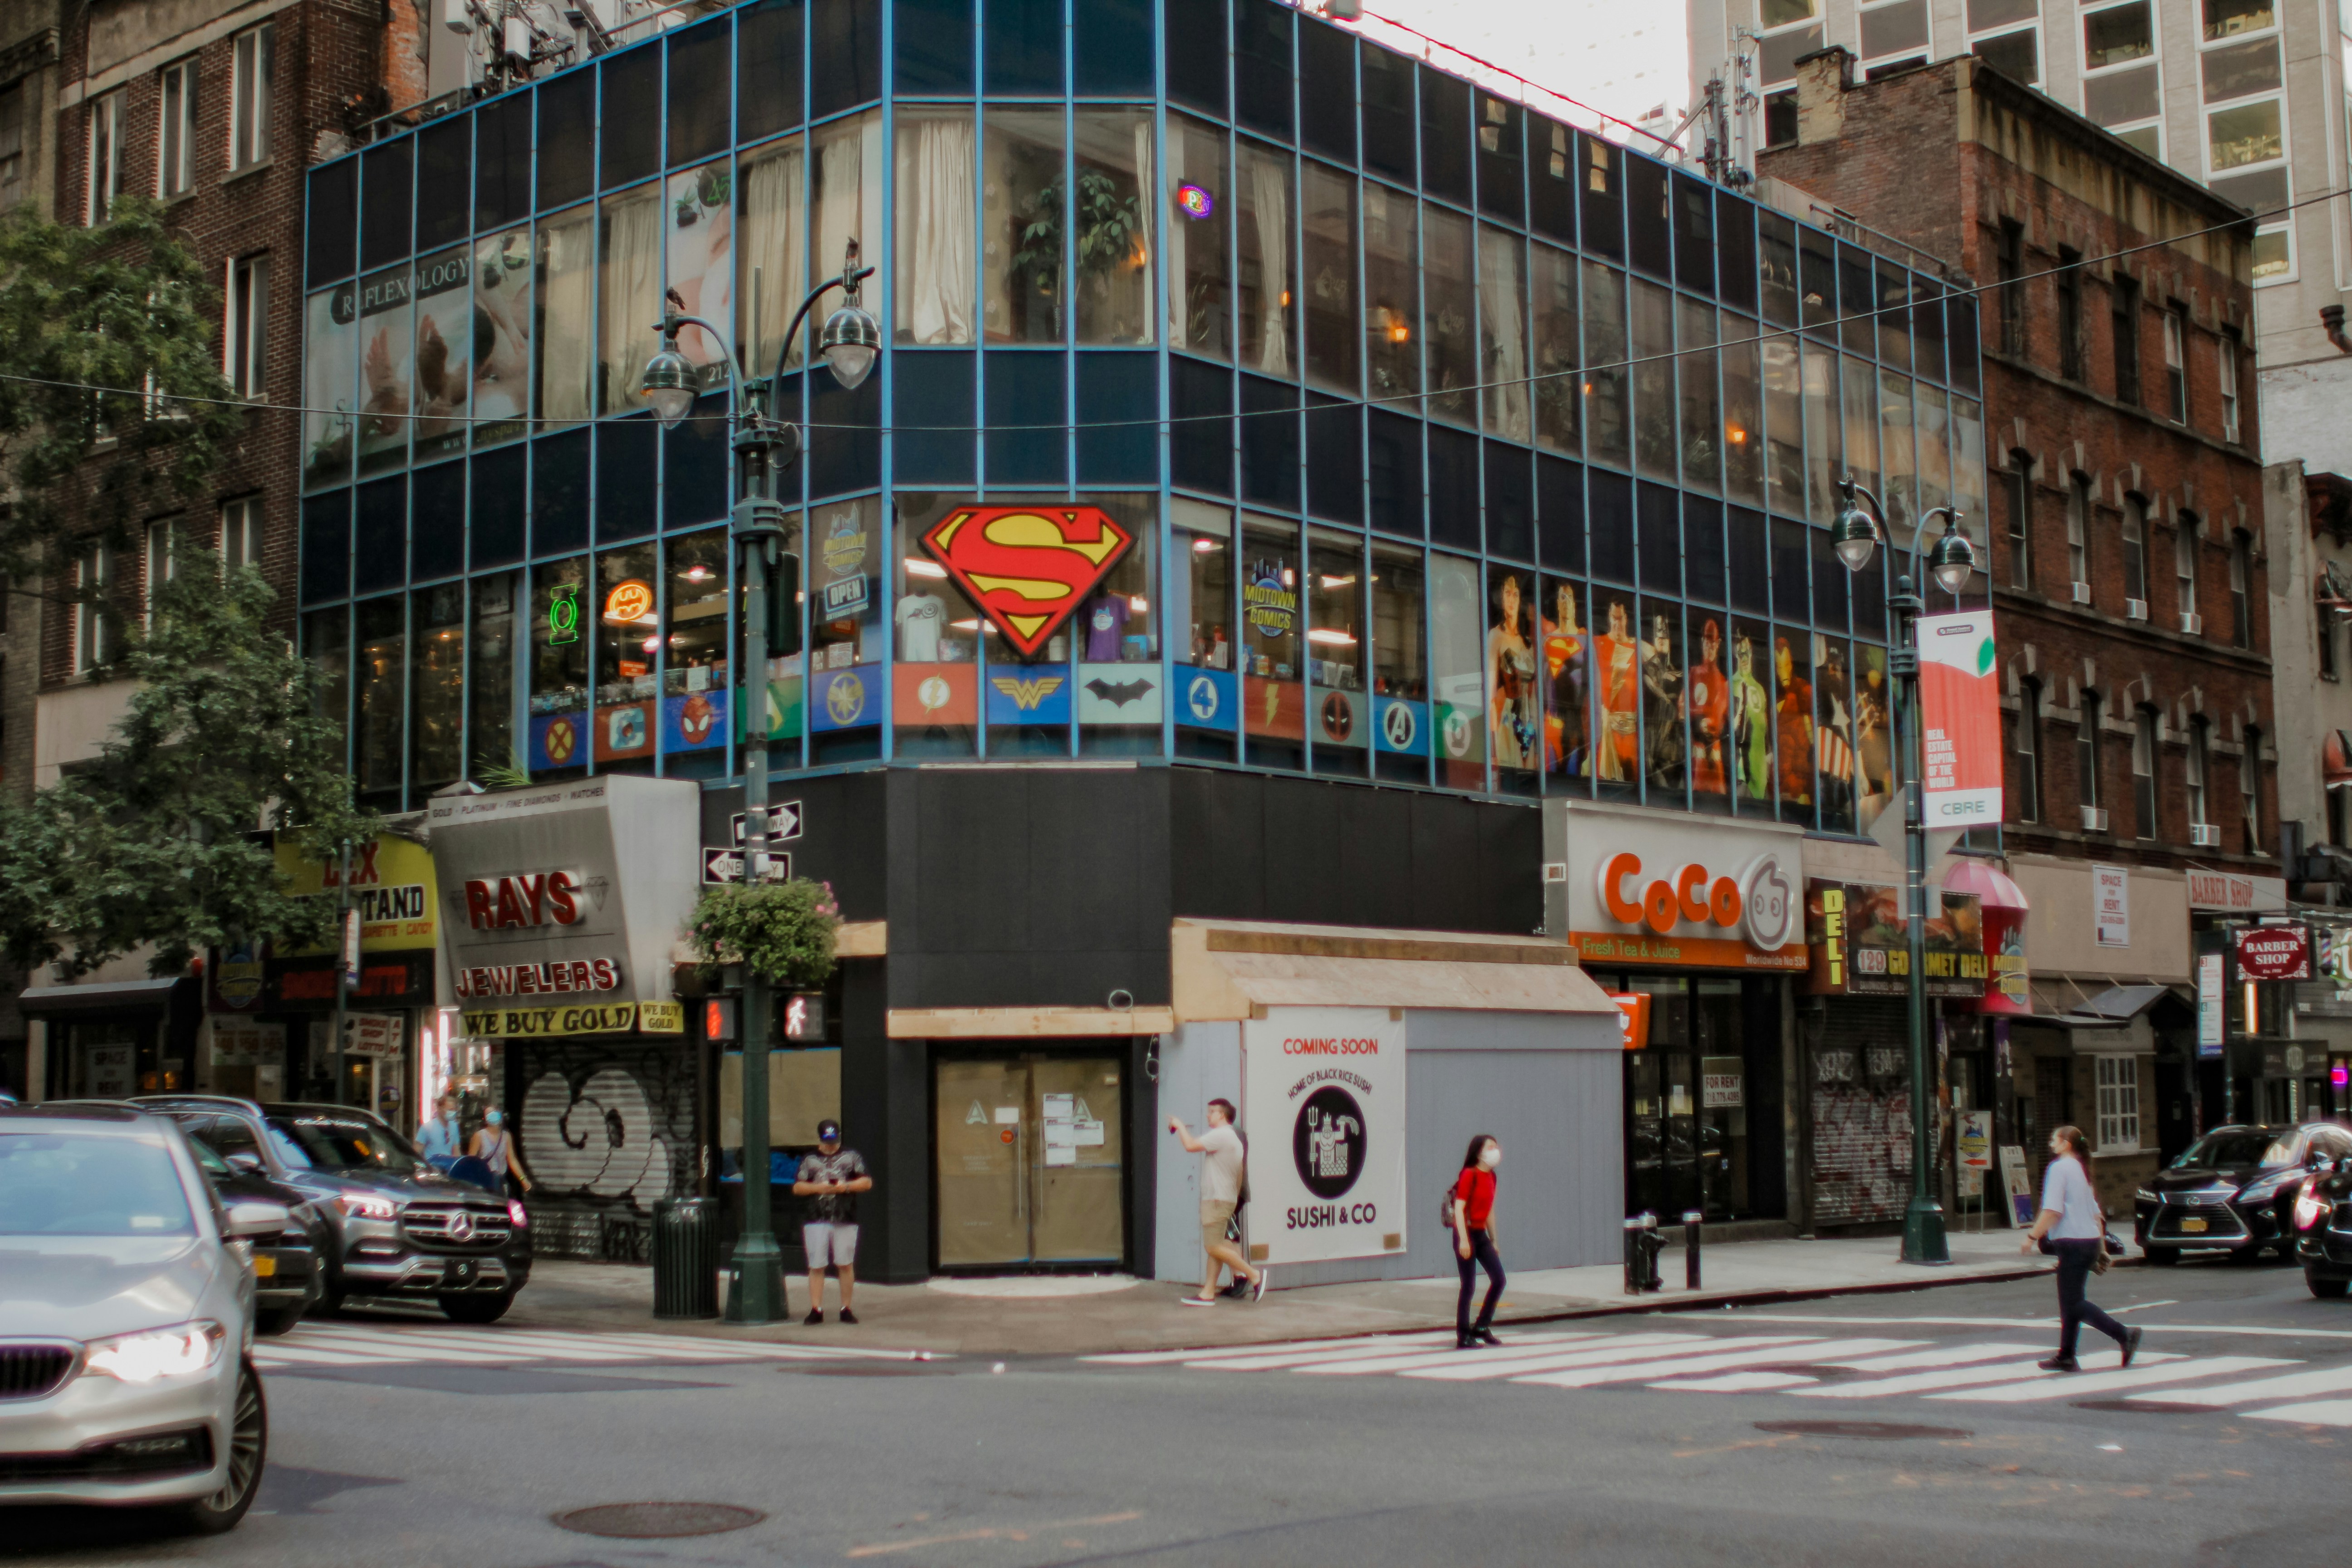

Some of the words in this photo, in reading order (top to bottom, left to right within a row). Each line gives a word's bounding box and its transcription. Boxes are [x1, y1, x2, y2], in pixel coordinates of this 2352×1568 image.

[343, 258, 470, 315] RFLEXOLOGY
[823, 531, 867, 554] MIDTOWN
[828, 551, 862, 568] COMICS
[830, 579, 861, 606] OPEN
[1244, 584, 1296, 609] MIDTOWN
[1250, 608, 1292, 629] COMICS
[1927, 729, 1945, 740] REAL
[1927, 740, 1952, 752] ESTATE
[1928, 751, 1957, 764] CAPITAL
[1929, 765, 1937, 776] OF
[1939, 764, 1953, 775] THE
[1929, 776, 1955, 788] WORLD
[433, 808, 453, 818] GOLD
[461, 802, 498, 814] PLATINUM
[505, 799, 522, 808] FINE
[524, 793, 562, 807] DIAMONDS
[570, 787, 605, 800] WATCHES
[1940, 800, 1985, 815] CBRE
[772, 815, 791, 830] WAY
[718, 860, 742, 874] ONE
[2101, 874, 2122, 887] SPACE
[2190, 875, 2228, 906] BARBER
[2230, 878, 2253, 908] SHOP
[466, 871, 580, 930] RAYS
[2104, 899, 2120, 911] RENT
[1823, 889, 1843, 985] DELI
[1583, 938, 1615, 956] Fresh
[1617, 940, 1637, 957] Tea
[1641, 941, 1650, 957] &
[1652, 943, 1681, 959] Juice
[2245, 941, 2299, 953] BARBER
[1745, 954, 1783, 967] Worldwide
[1784, 956, 1793, 966] No
[1794, 956, 1807, 967] 534
[1859, 950, 1886, 971] 129
[1960, 954, 1989, 978] DELI
[2255, 954, 2291, 965] SHOP
[456, 958, 618, 998] JEWELERS
[643, 1005, 660, 1017] WE
[660, 1004, 680, 1017] BUY
[358, 1018, 387, 1028] SMOKE
[465, 1013, 499, 1035] WE
[506, 1010, 556, 1034] BUY
[563, 1006, 631, 1031] GOLD
[648, 1017, 673, 1029] GOLD
[360, 1029, 383, 1038] SHOP
[357, 1043, 384, 1052] LOTTO
[1283, 1038, 1338, 1055] COMING
[1341, 1038, 1378, 1055] SOON
[1288, 1077, 1307, 1101] HOME
[1306, 1072, 1315, 1085] OF
[1316, 1068, 1338, 1082] BLACK
[1338, 1069, 1353, 1083] RICE
[1352, 1074, 1372, 1095] SUSHI
[1705, 1076, 1720, 1089] FOR
[1720, 1076, 1740, 1089] RENT
[1286, 1204, 1336, 1230] SUSHI
[1339, 1207, 1348, 1224] &
[1352, 1203, 1377, 1224] CO
